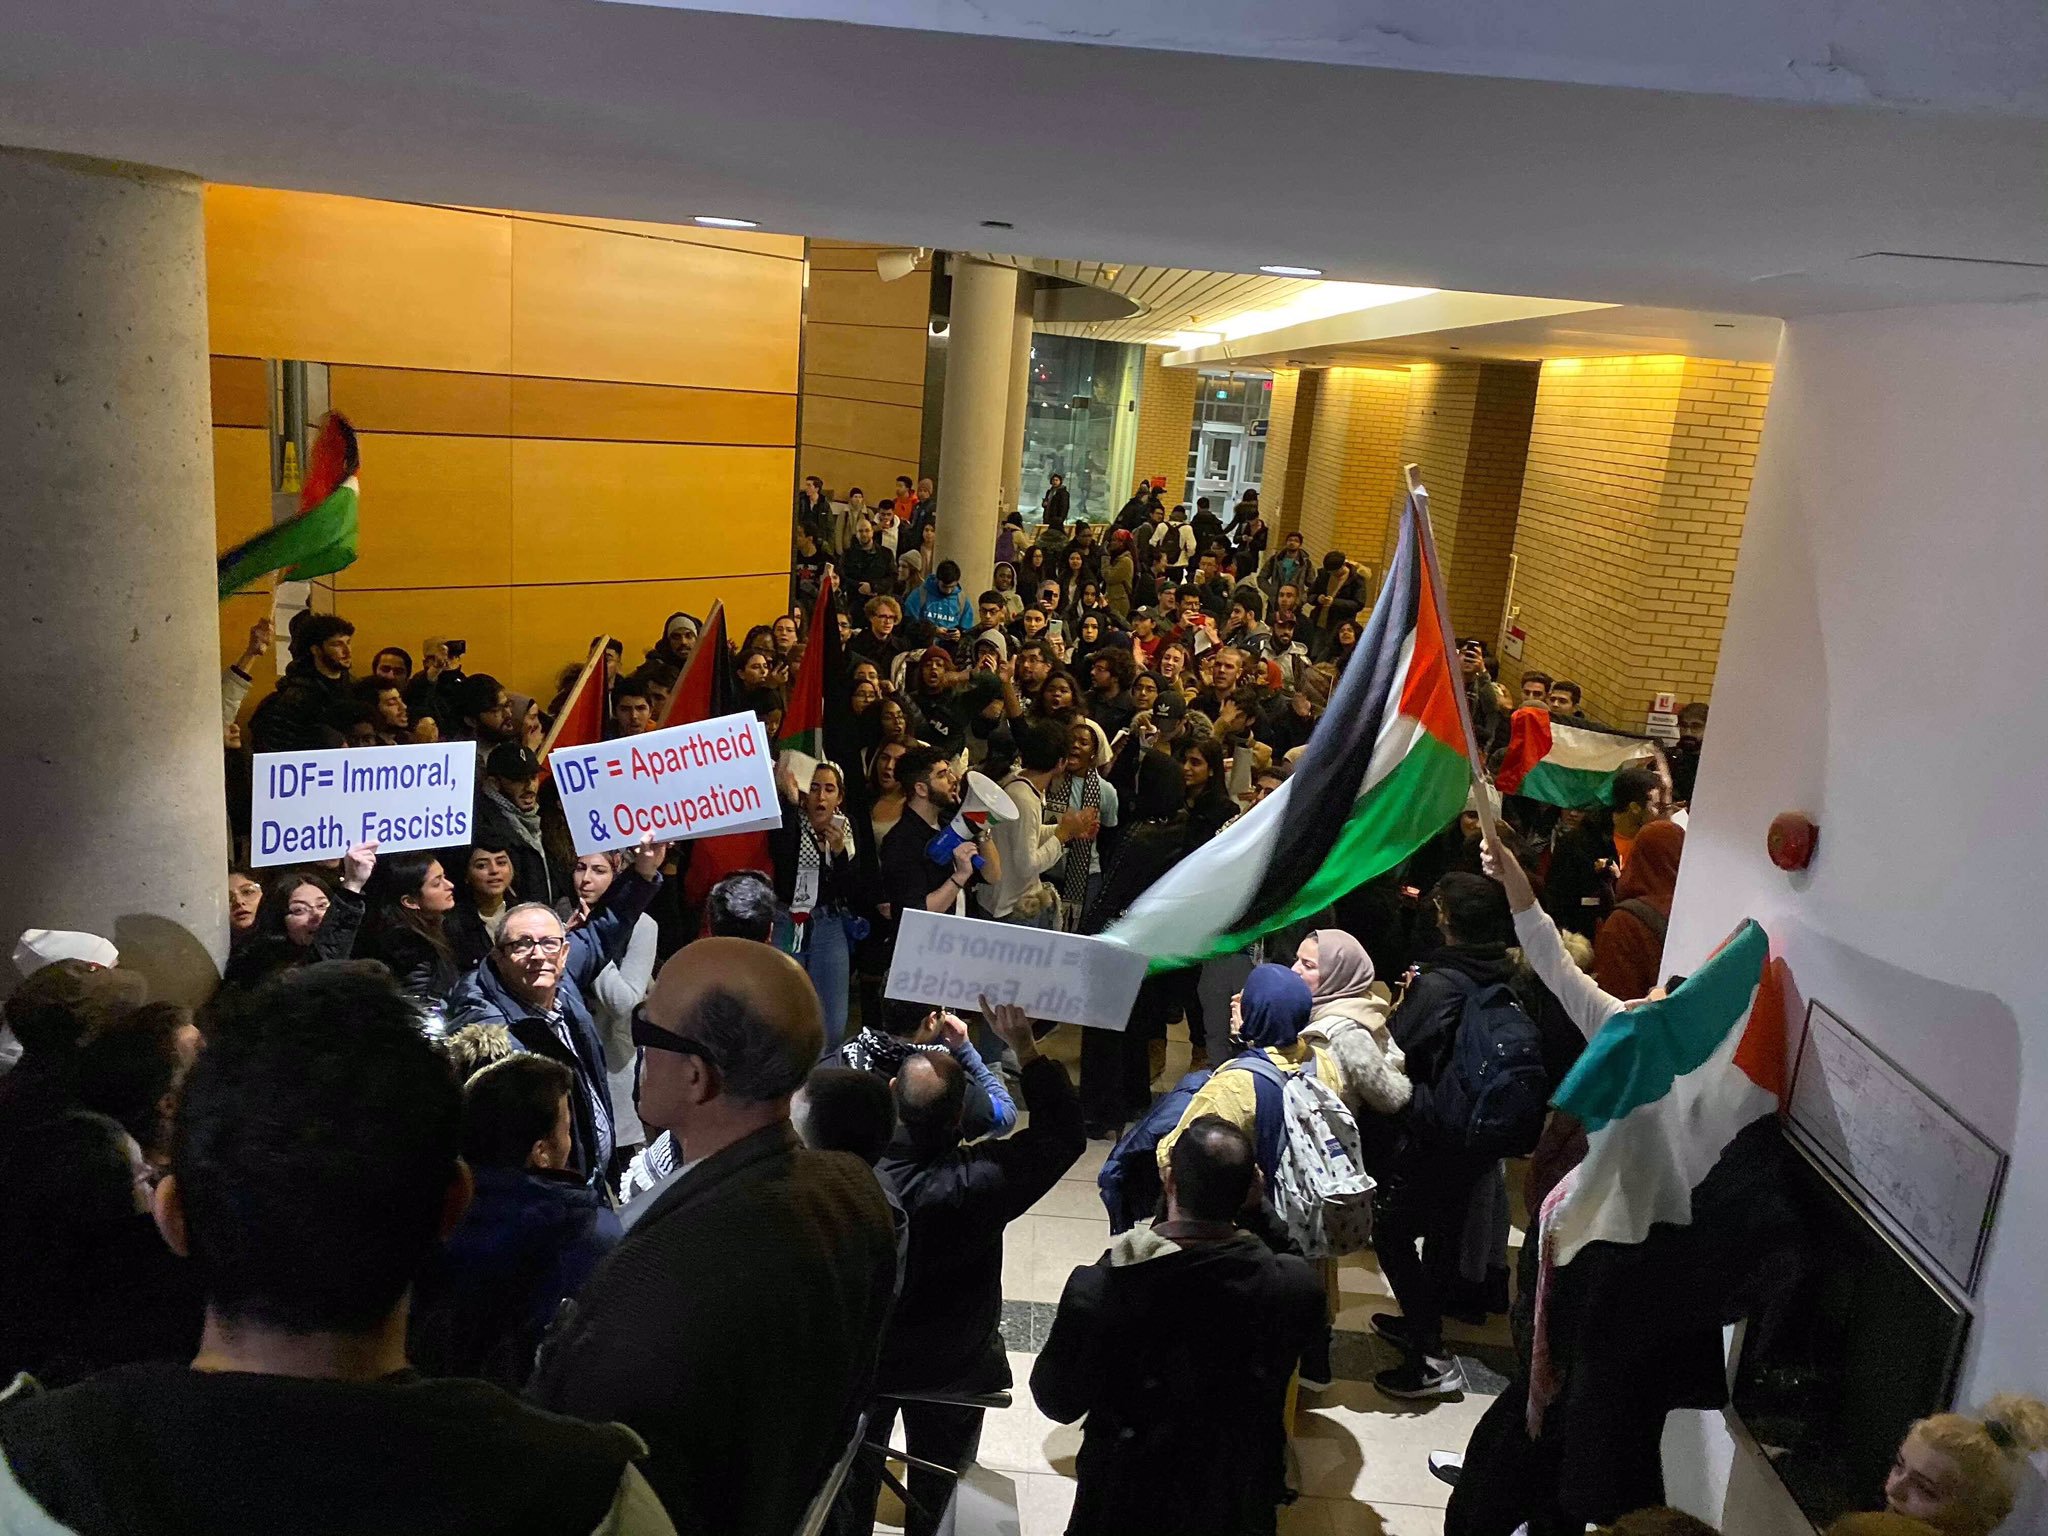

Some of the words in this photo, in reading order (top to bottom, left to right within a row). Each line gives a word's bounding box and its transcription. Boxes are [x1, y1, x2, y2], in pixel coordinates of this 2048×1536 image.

[342, 753, 457, 794] Immoral,
[557, 756, 600, 795] IDF
[606, 759, 624, 777] =
[631, 723, 757, 785] Apartheid
[261, 814, 351, 855] Death,
[361, 805, 467, 844] Fascists
[588, 809, 611, 842] &
[613, 783, 762, 837] Occupation
